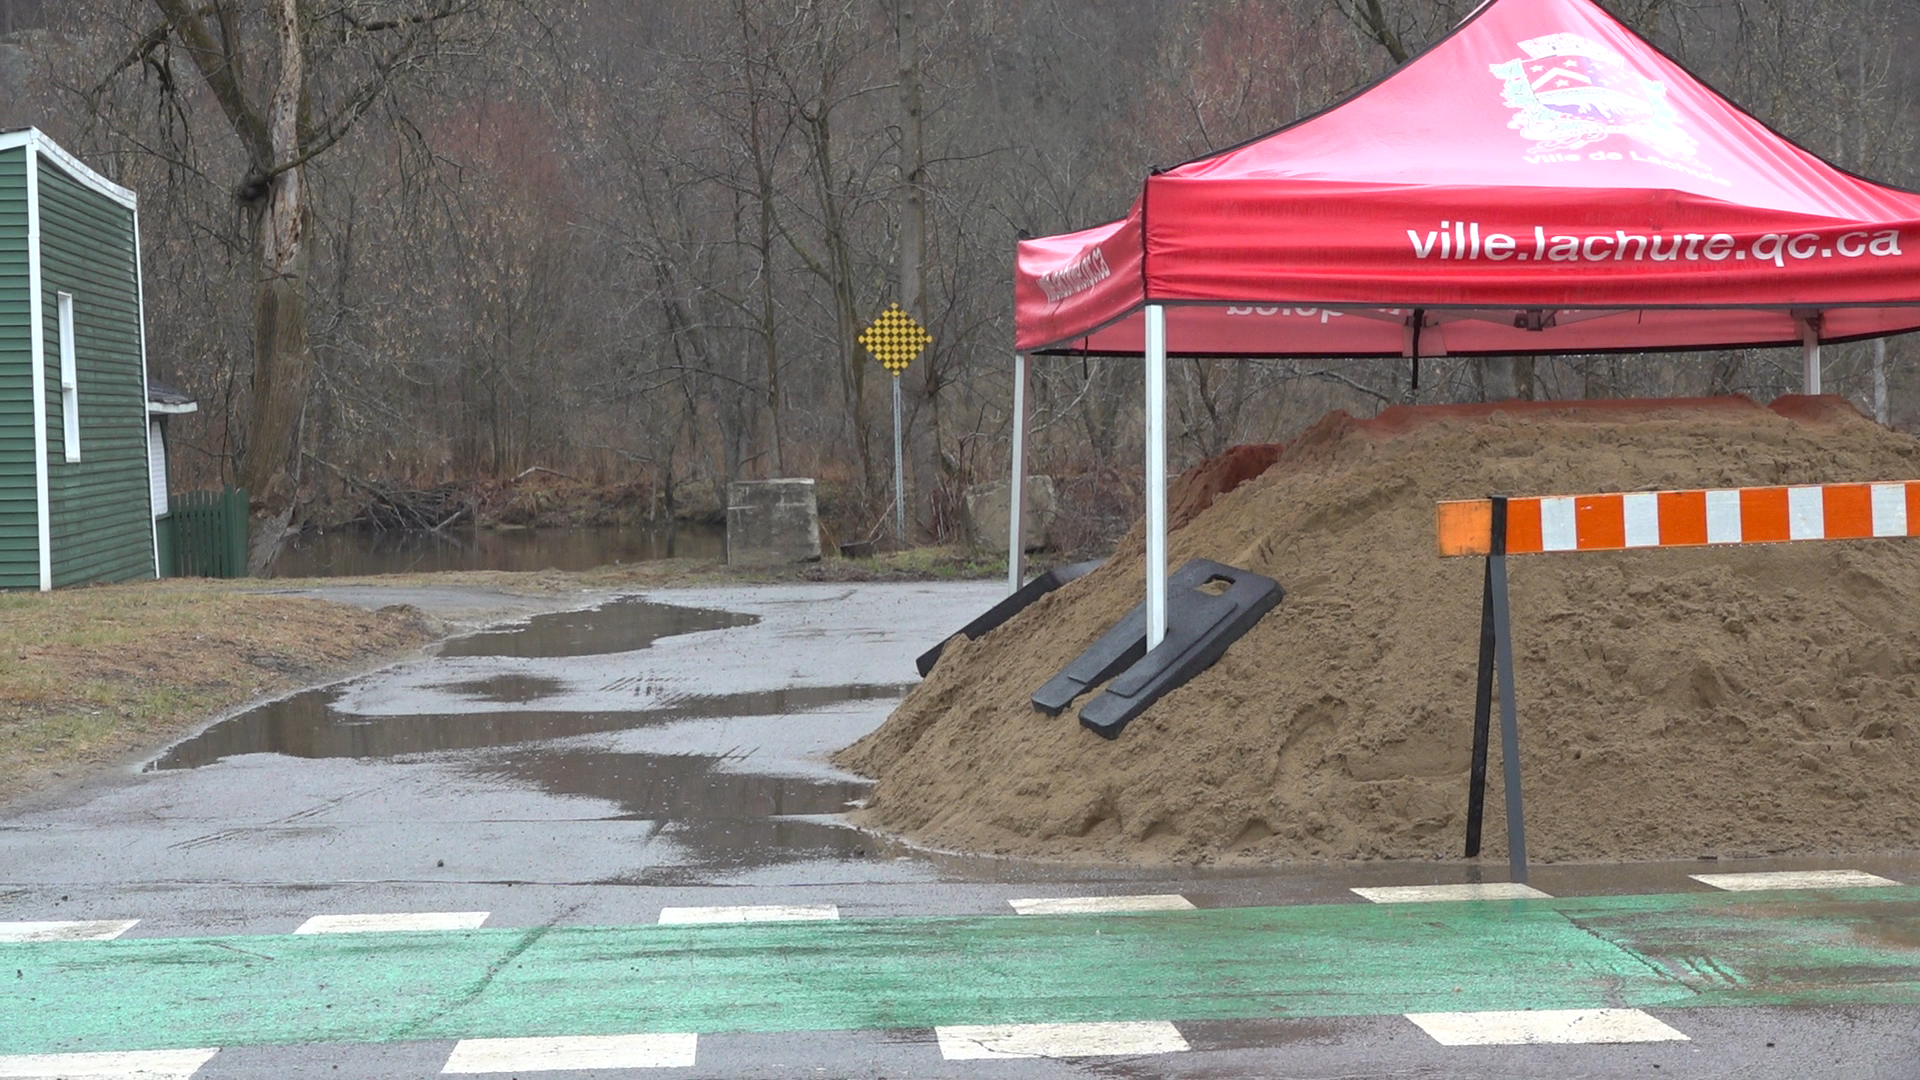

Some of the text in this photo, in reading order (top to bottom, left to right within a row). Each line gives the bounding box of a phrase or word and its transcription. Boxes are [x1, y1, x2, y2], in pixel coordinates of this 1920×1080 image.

[1522, 150, 1732, 187] Ville de Lachute
[1406, 221, 1903, 268] ville.lachute.qc.ca
